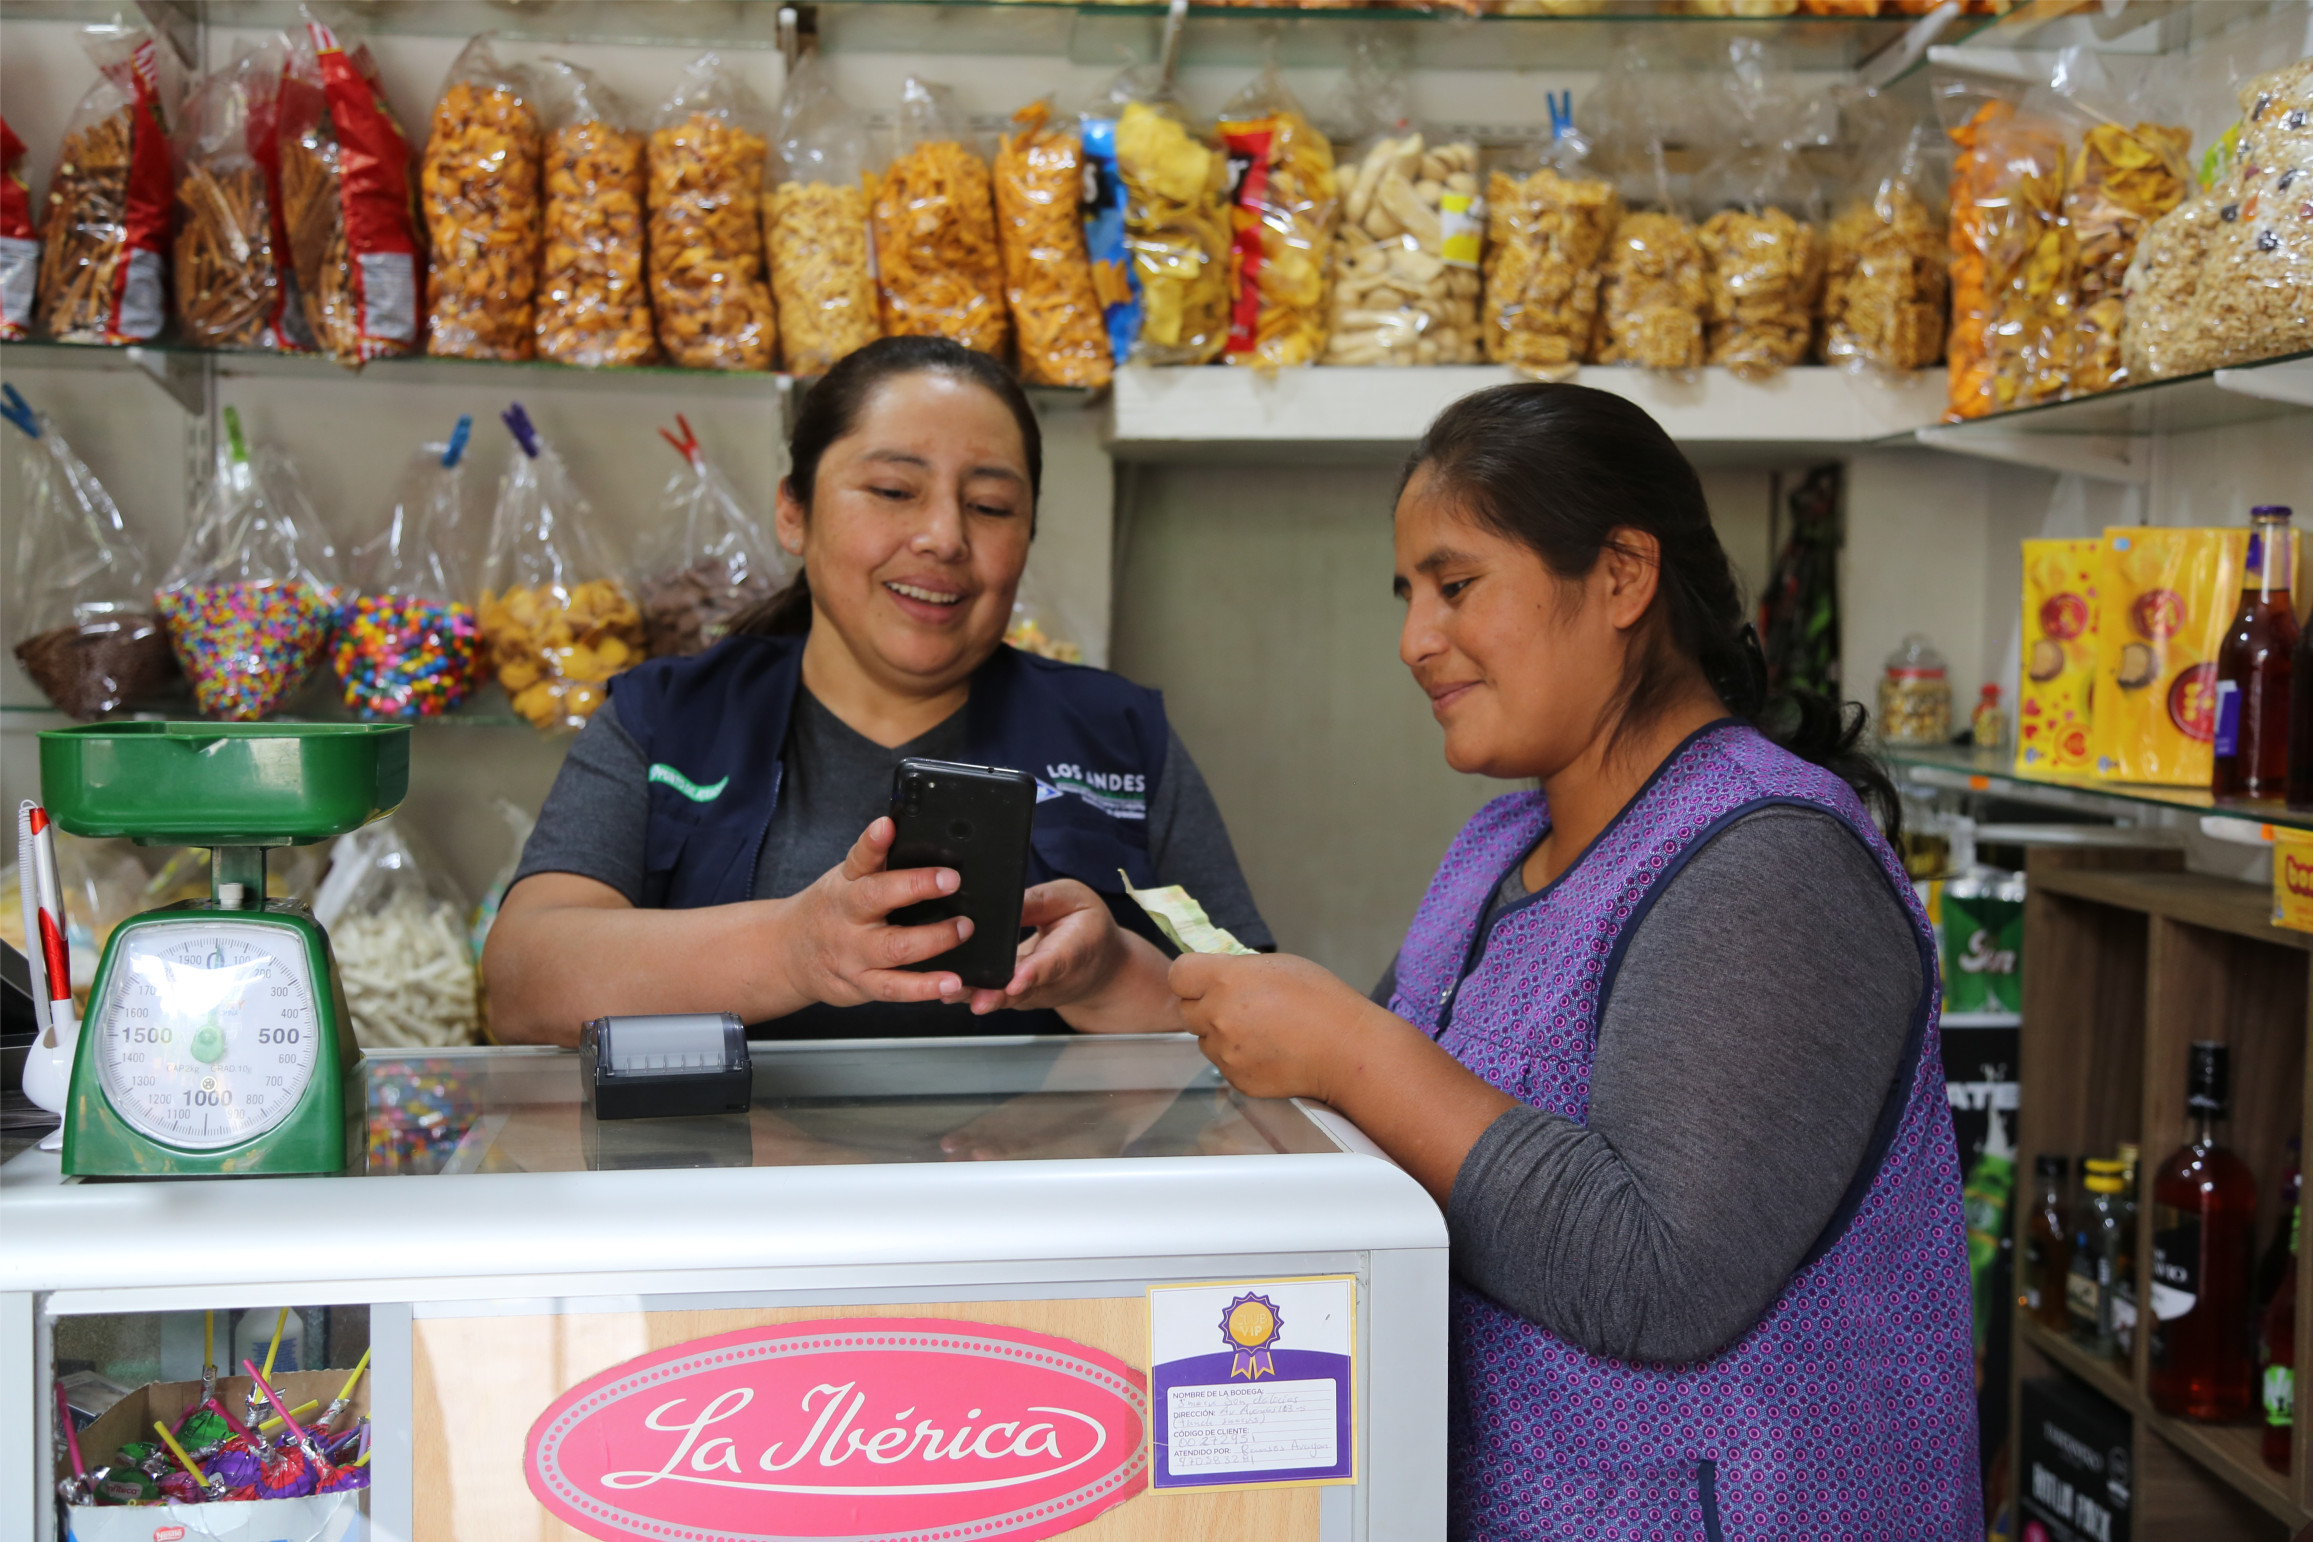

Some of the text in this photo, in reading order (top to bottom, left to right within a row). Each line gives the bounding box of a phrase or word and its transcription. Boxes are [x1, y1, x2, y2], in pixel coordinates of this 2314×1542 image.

[1046, 763, 1083, 781] LOS
[179, 954, 202, 965] 1900
[234, 955, 251, 966] 100
[254, 968, 272, 980] 200
[271, 986, 288, 997] 300
[125, 1008, 299, 1019] 1600 400
[122, 1027, 300, 1044] 1500 500
[122, 1053, 296, 1064] 1400 600
[132, 1076, 283, 1087] 1300 700
[149, 1090, 264, 1107] 1200 1000 800
[167, 1109, 245, 1120] 1100 900
[1235, 1313, 1268, 1326] CLUB
[1240, 1325, 1263, 1337] VIP
[1173, 1391, 1205, 1399] NOMBRE
[1230, 1388, 1264, 1396] BODEGA:
[1173, 1408, 1215, 1419] DIRECCIÓN:
[601, 1381, 1075, 1489] La Ibérica
[1174, 1430, 1203, 1438] CÓDIGO
[1217, 1428, 1249, 1436] CLIENTE:
[1174, 1449, 1212, 1457] ATENDIDO
